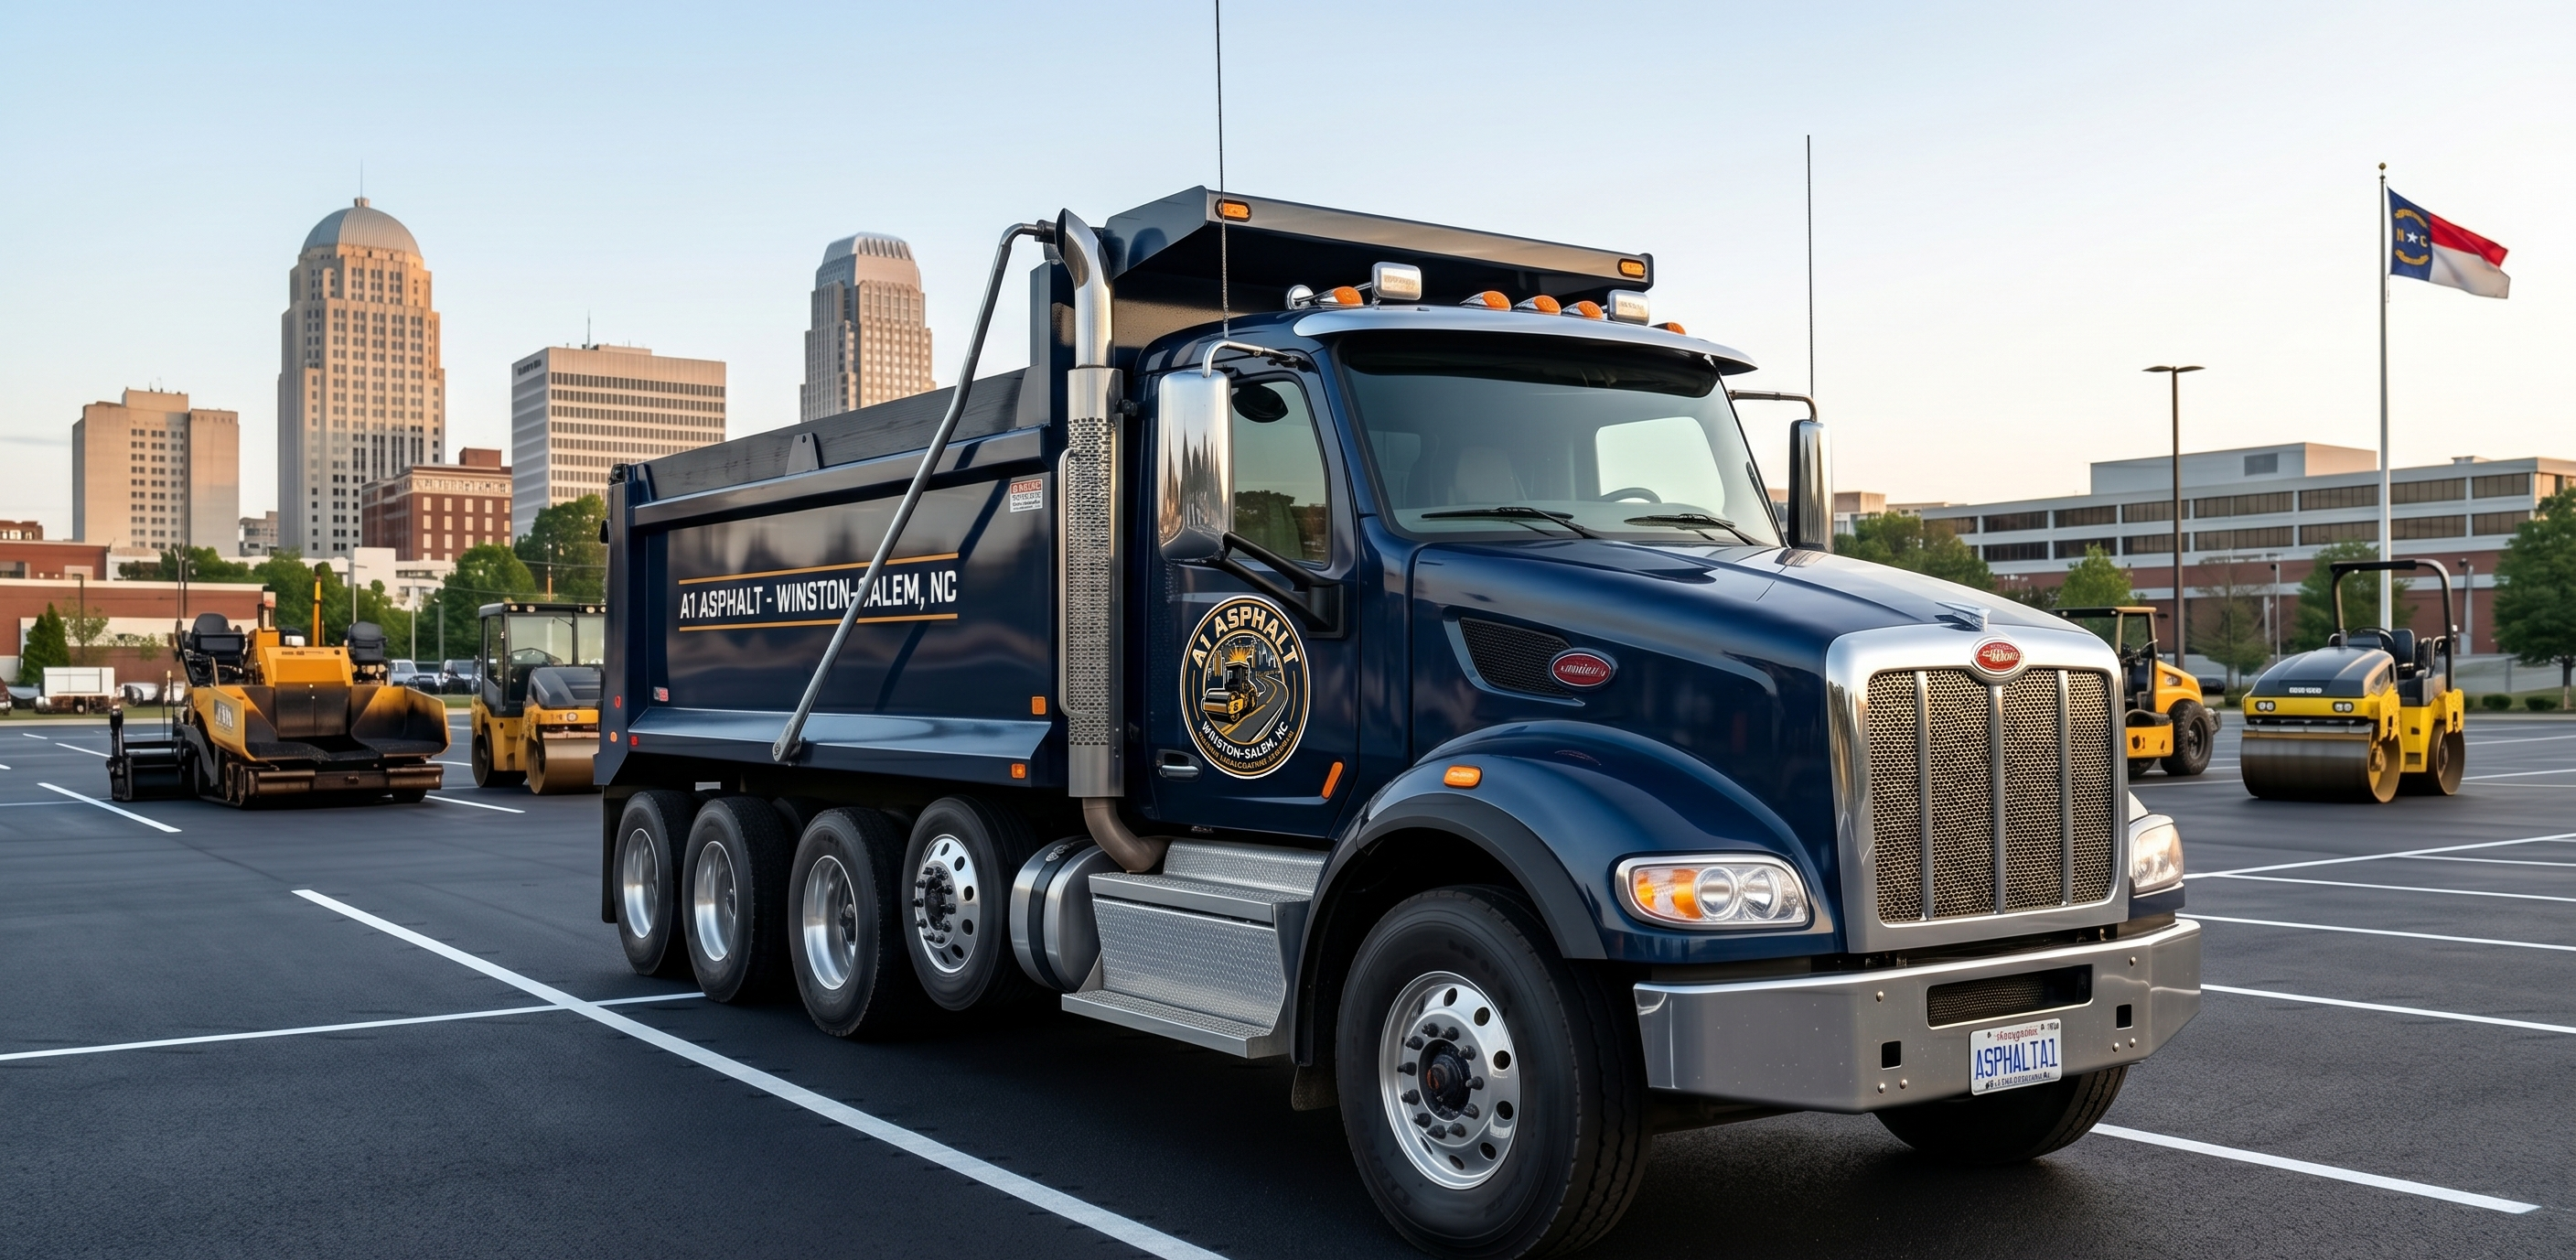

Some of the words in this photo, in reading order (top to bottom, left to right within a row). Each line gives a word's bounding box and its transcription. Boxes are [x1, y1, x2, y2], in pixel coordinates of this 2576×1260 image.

[680, 591, 696, 619] A1
[699, 586, 764, 619] ASPHALT
[930, 569, 957, 604] NC
[1192, 633, 1212, 669] A1
[1213, 606, 1300, 665] ASPHALT
[1974, 1038, 2058, 1081] ASPHALTA1
